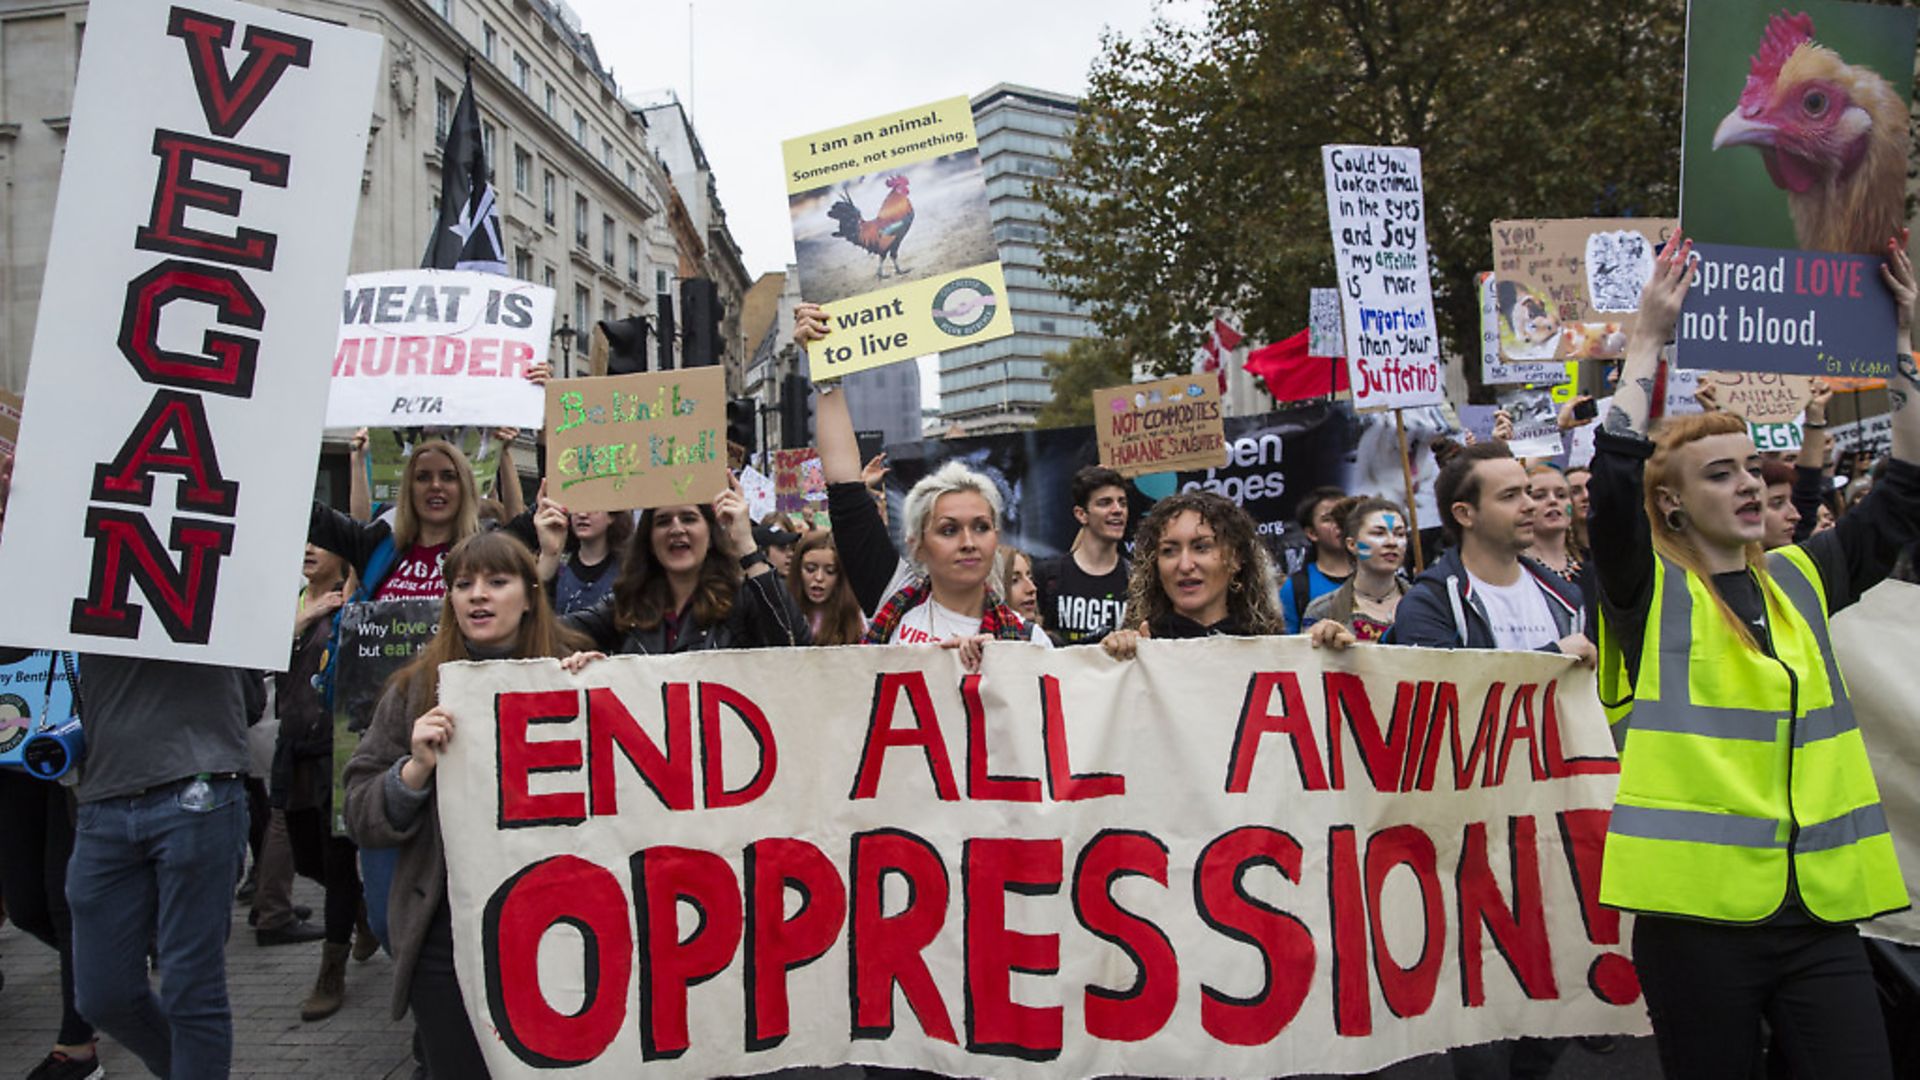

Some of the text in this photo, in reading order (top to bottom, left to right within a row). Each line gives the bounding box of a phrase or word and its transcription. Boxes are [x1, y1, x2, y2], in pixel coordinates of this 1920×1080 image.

[809, 110, 943, 155] I am an animal.
[792, 129, 969, 182] Someone, not something.
[1330, 149, 1376, 174] Could
[1339, 196, 1420, 222] in the eyes
[1342, 223, 1373, 246] and
[1498, 227, 1535, 246] YOU
[1347, 271, 1416, 298] is more
[1686, 250, 1785, 296] Spread
[1795, 258, 1864, 298] LOVE
[343, 285, 533, 329] MEAT IS
[837, 298, 904, 330] want
[1359, 302, 1426, 335] important
[70, 5, 313, 645] VEGAN
[1682, 306, 1823, 347] not blood.
[331, 336, 535, 378] MURDER
[824, 331, 908, 364] to live
[1359, 334, 1392, 356] than
[1850, 359, 1891, 377] Vegan
[555, 383, 697, 434] Be kind to
[1729, 388, 1801, 403] ANIMAL
[1745, 402, 1796, 417] ABUSE
[1112, 410, 1143, 437] NOT
[557, 429, 718, 491] every kind!
[1182, 471, 1285, 508] cages
[358, 623, 389, 638] Why
[391, 618, 428, 634] love
[899, 623, 942, 644] VIR
[359, 645, 381, 657] but
[384, 643, 412, 656] eat
[496, 669, 1619, 829] END ALL ANIMAL
[483, 809, 1642, 1063] OPPRESSION!
